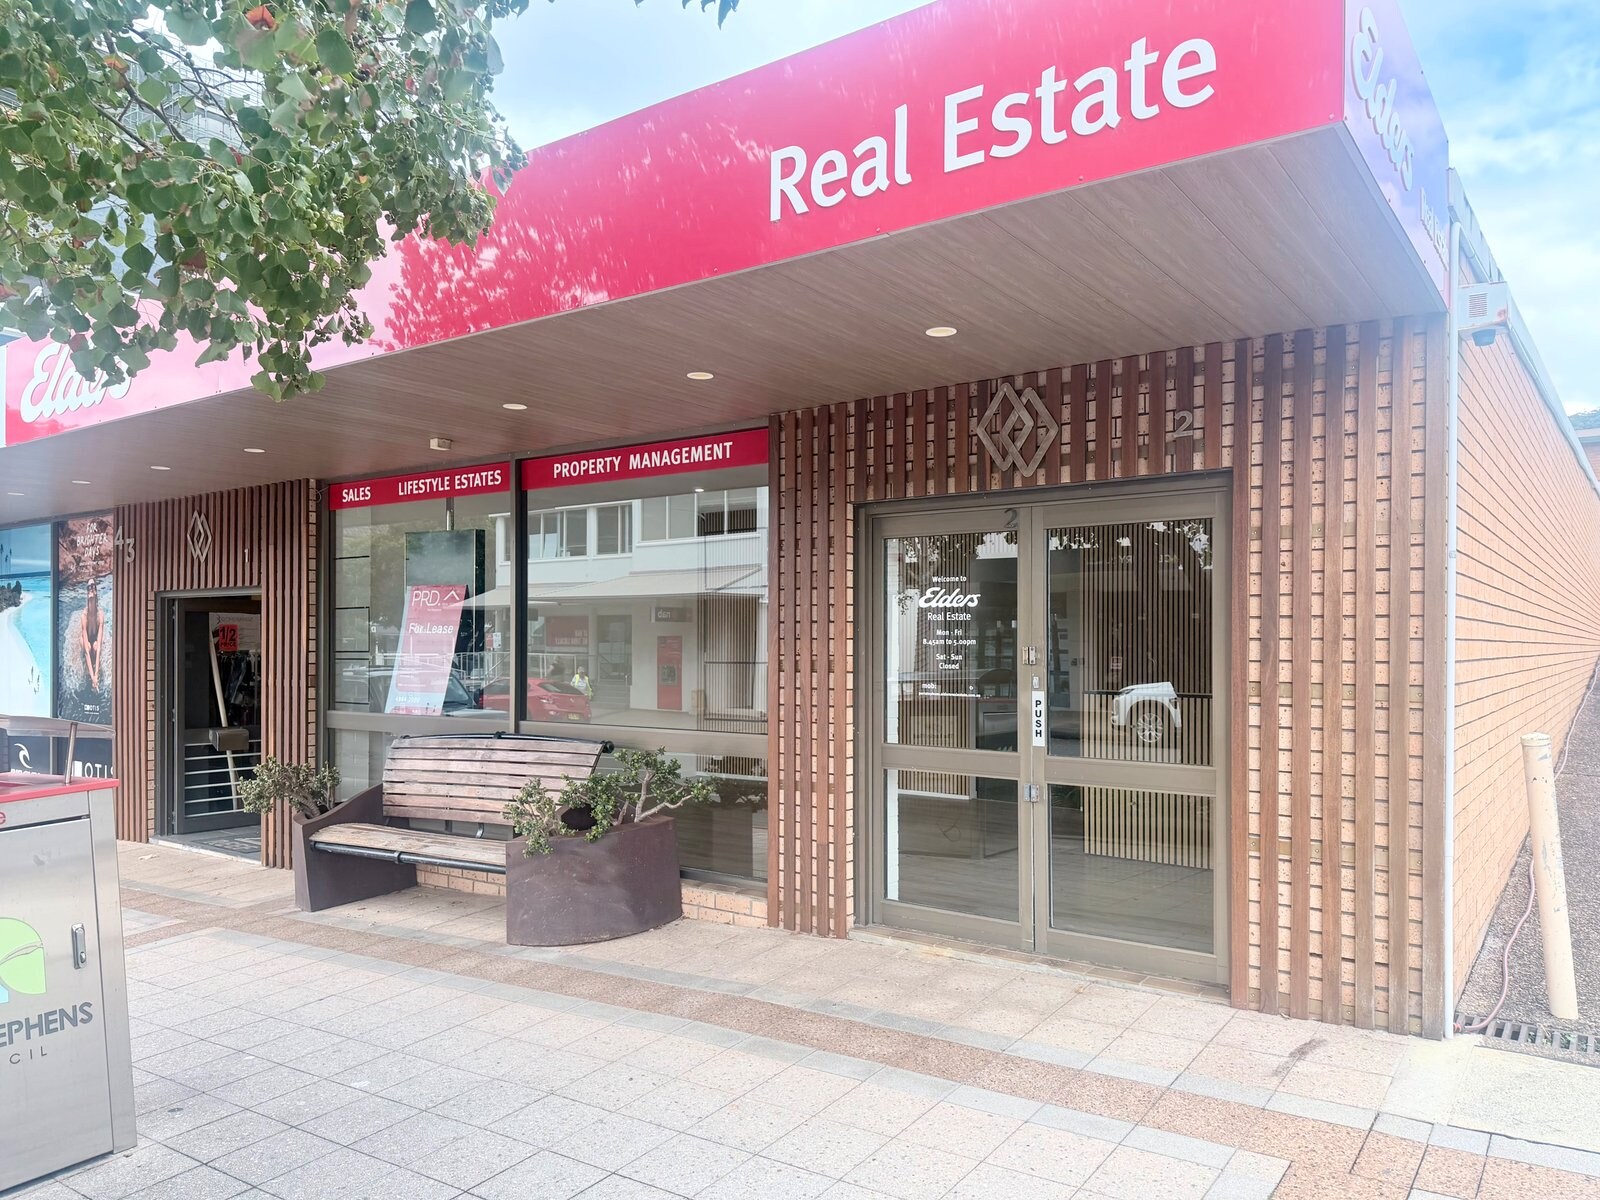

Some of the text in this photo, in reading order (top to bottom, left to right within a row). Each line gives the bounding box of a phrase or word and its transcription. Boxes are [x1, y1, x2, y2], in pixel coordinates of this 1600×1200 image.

[1351, 7, 1413, 191] Elders
[770, 36, 1217, 222] Real Estate
[1172, 410, 1194, 438] 2
[553, 441, 733, 479] PROPERTY MANAGEMENT
[342, 469, 502, 503] SALES LIFESTYLE ESTATES
[86, 522, 98, 534] FOR
[76, 532, 108, 548] BRIGHTER
[84, 545, 100, 561] DAYS
[919, 586, 981, 608] Elders
[927, 611, 972, 621] Real Estate
[426, 622, 454, 634] Lease
[954, 628, 962, 636] Fri
